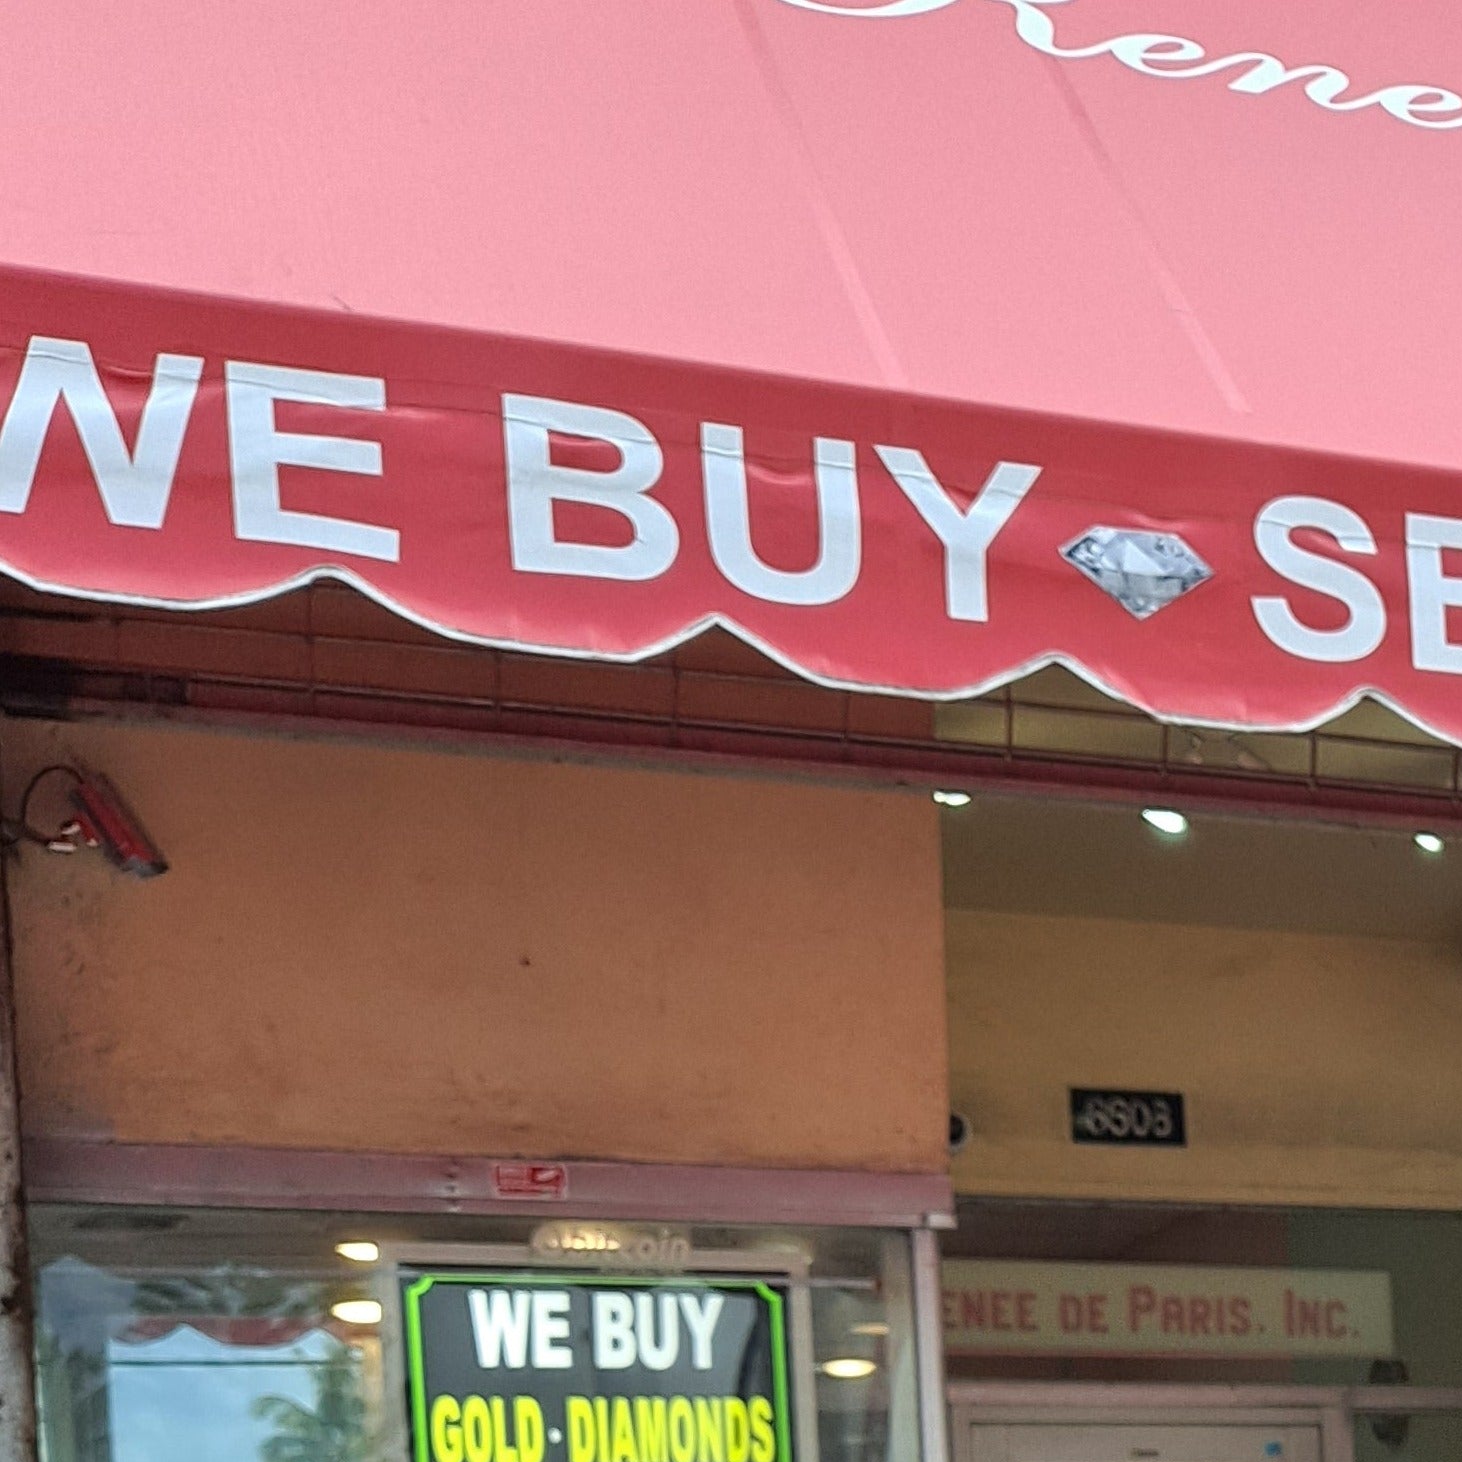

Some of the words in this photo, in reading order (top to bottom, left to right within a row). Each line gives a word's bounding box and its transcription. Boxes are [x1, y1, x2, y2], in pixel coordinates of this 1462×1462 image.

[0, 335, 401, 564] WE
[500, 392, 1043, 624] BUY
[468, 1289, 573, 1370] WE
[591, 1290, 726, 1370] BUY
